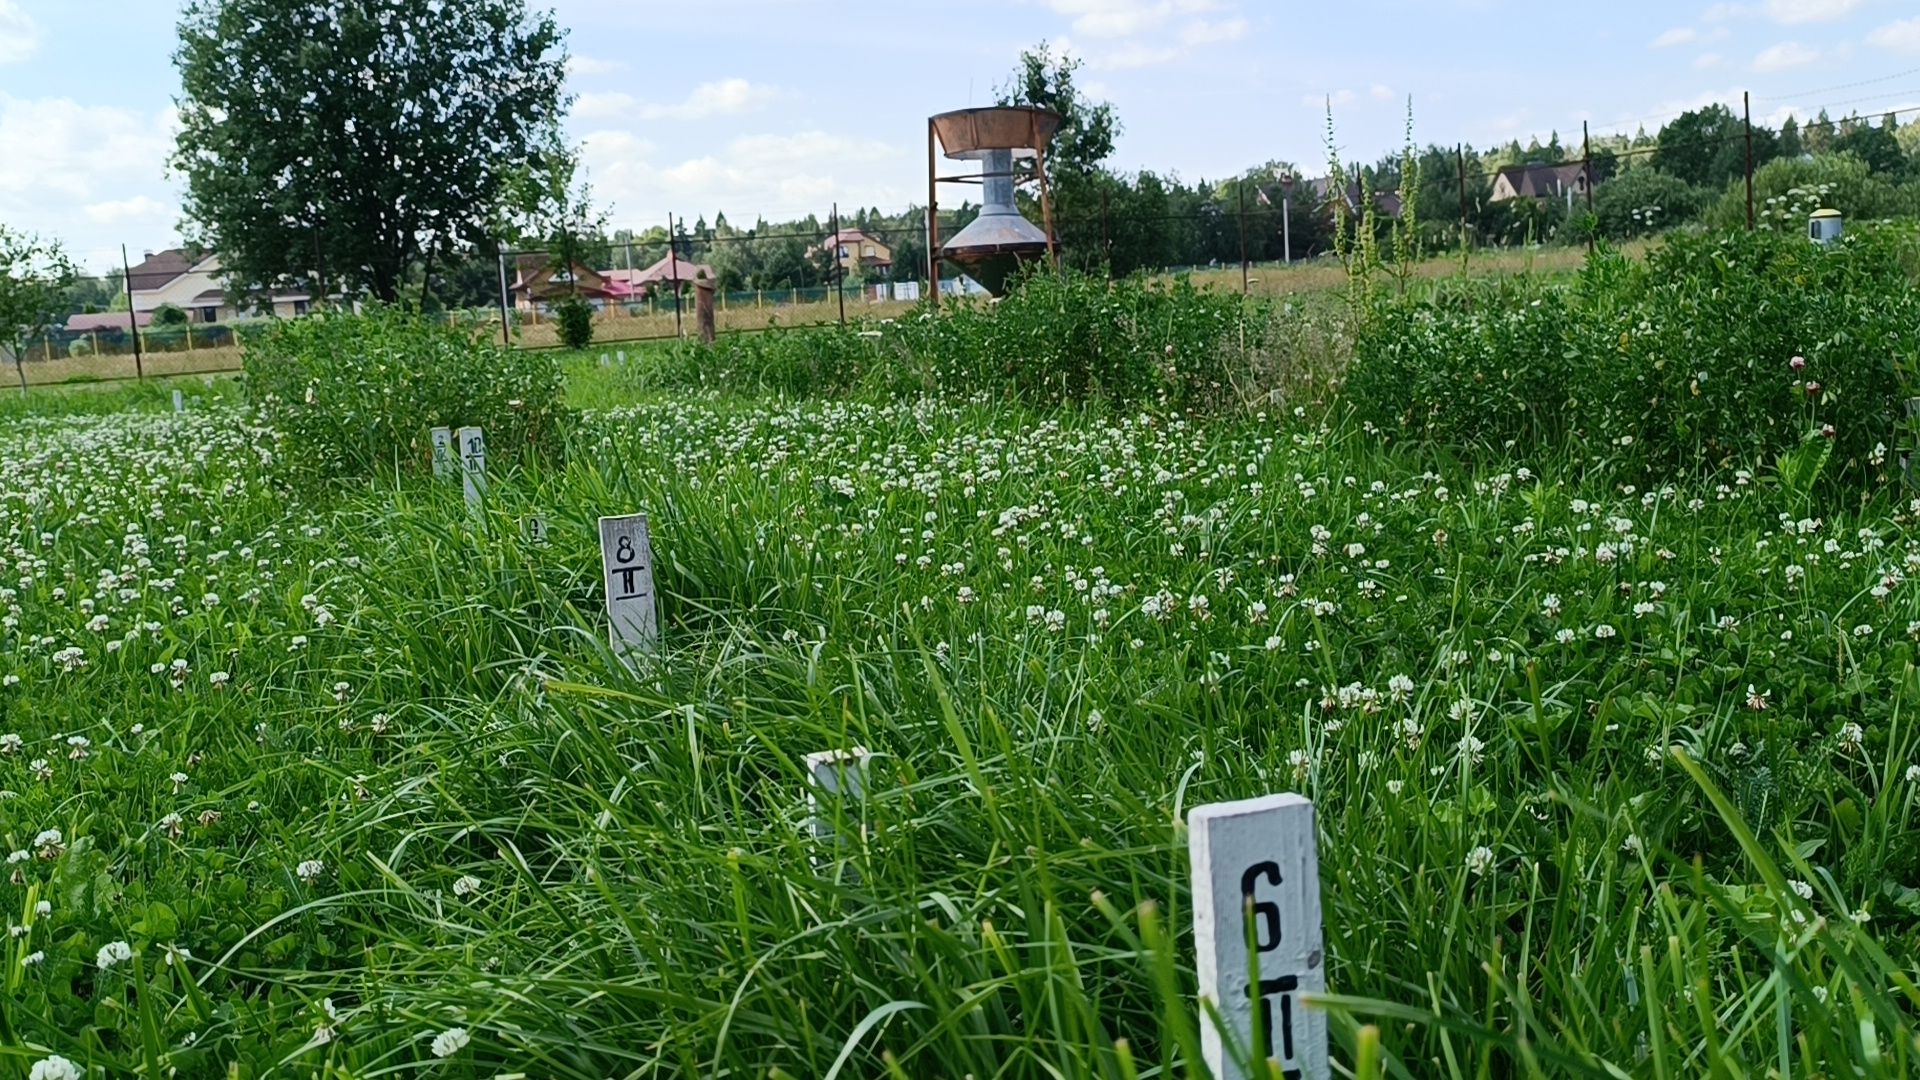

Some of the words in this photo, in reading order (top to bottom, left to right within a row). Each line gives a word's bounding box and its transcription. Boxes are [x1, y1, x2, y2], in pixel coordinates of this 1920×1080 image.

[467, 436, 482, 454] 10
[616, 535, 635, 564] 8
[1240, 861, 1283, 953] 6
